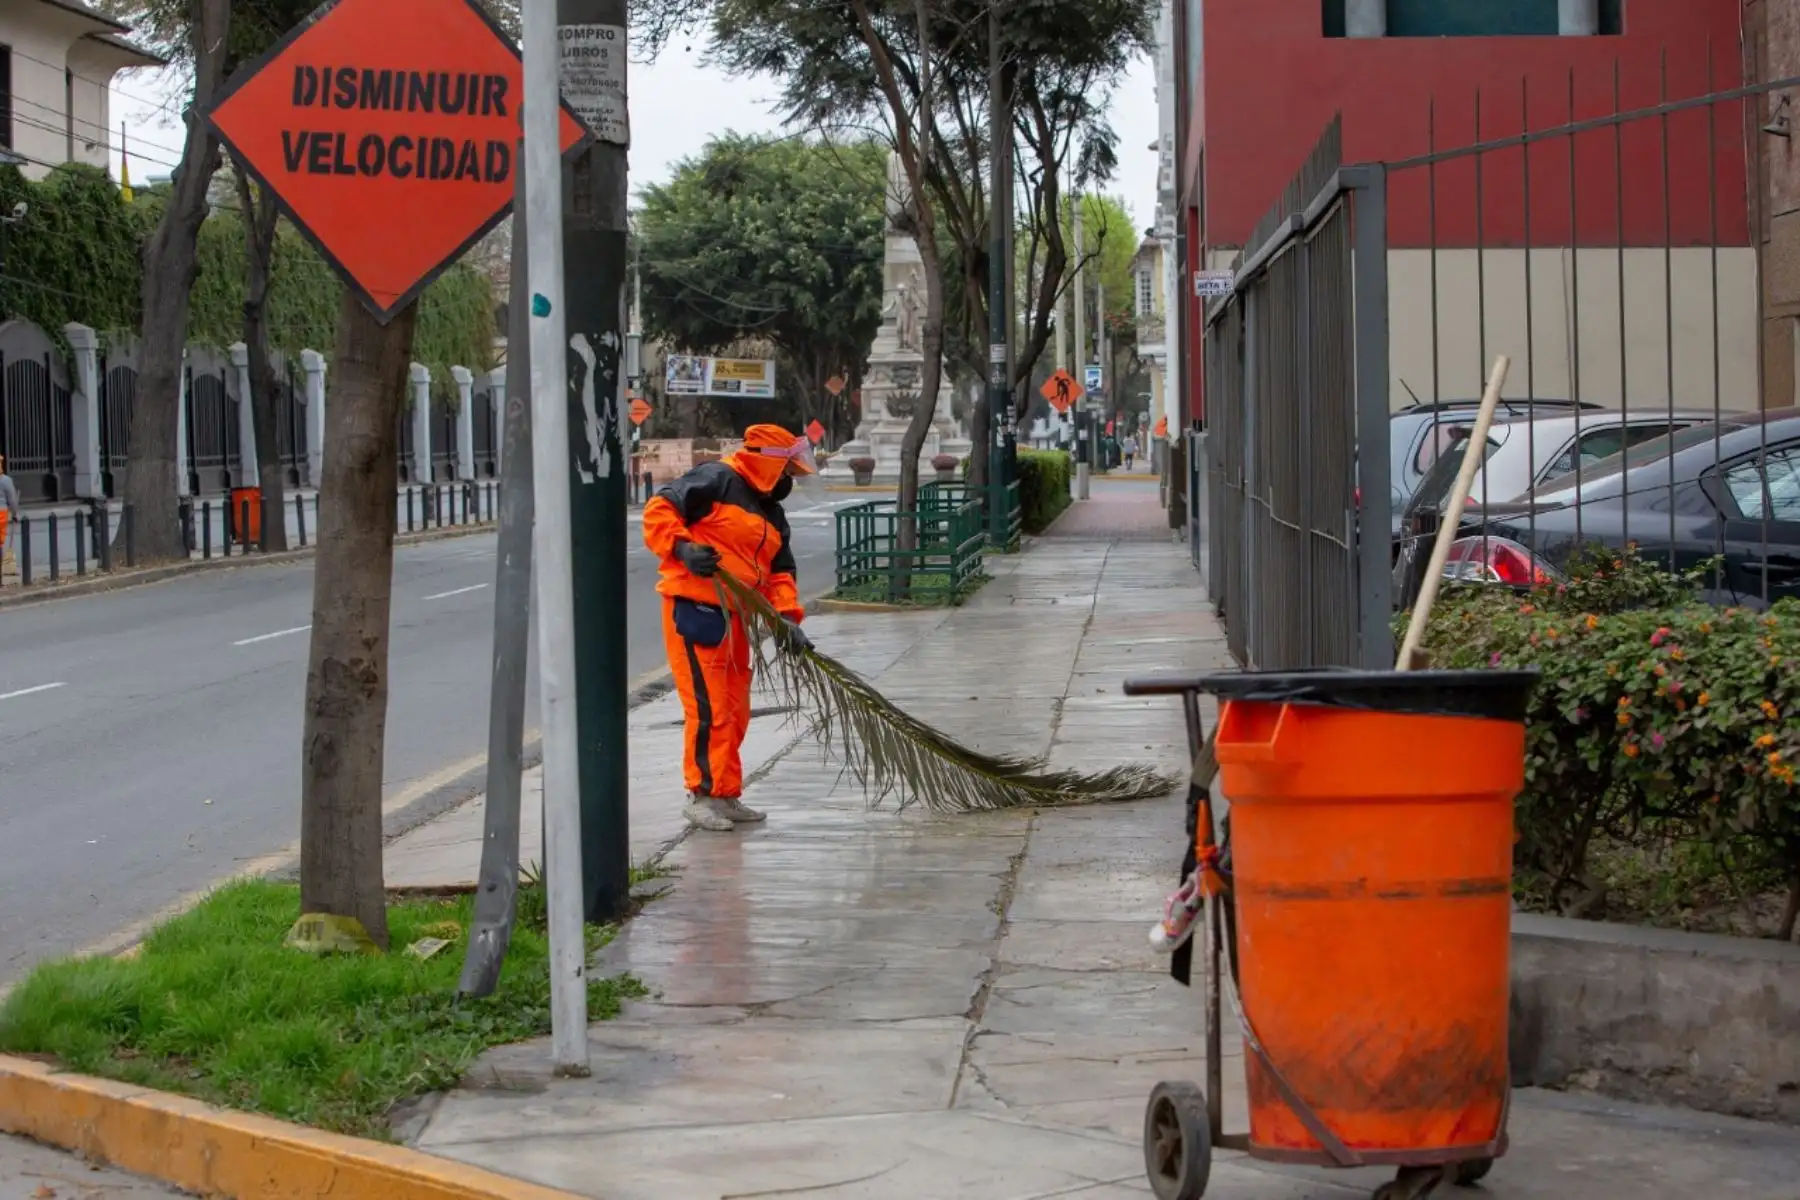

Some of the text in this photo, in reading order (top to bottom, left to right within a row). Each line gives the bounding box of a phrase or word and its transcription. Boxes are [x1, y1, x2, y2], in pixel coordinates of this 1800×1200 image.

[561, 46, 608, 58] LIBROS
[292, 65, 509, 117] DISMINUIR
[280, 129, 511, 184] VELOCIDAD
